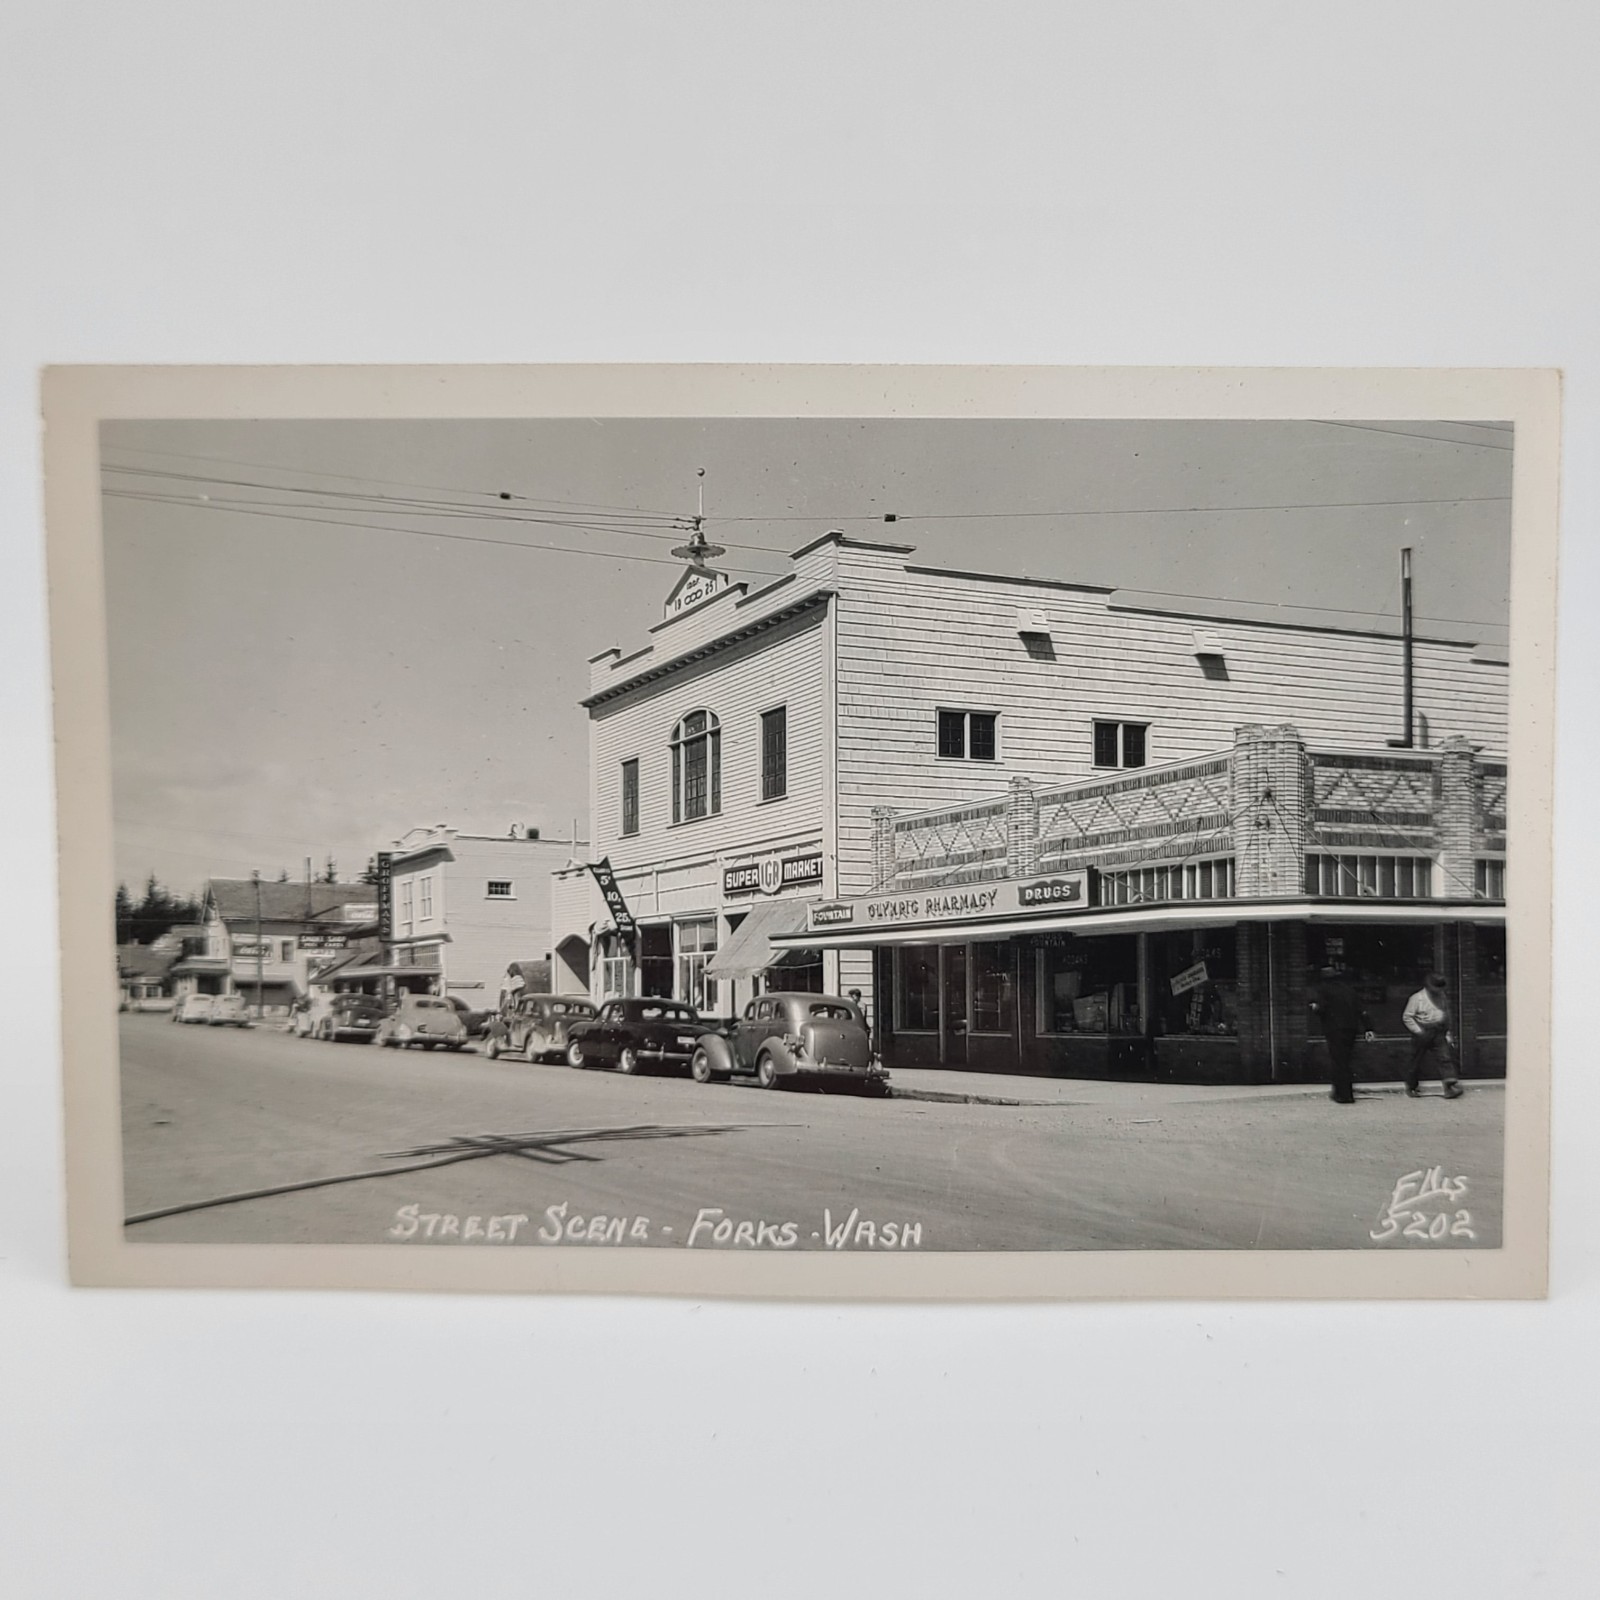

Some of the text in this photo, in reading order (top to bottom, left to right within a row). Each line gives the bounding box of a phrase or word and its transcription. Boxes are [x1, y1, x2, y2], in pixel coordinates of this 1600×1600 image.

[725, 855, 823, 888] SUPER IGA MARKET
[813, 884, 1072, 922] FOUNTAIN OLYMPIC PHARMACY DRUGS
[389, 1202, 528, 1240] STREET
[538, 1200, 649, 1240] SCENE
[686, 1207, 798, 1247] FORKS
[824, 1207, 923, 1249] WASH
